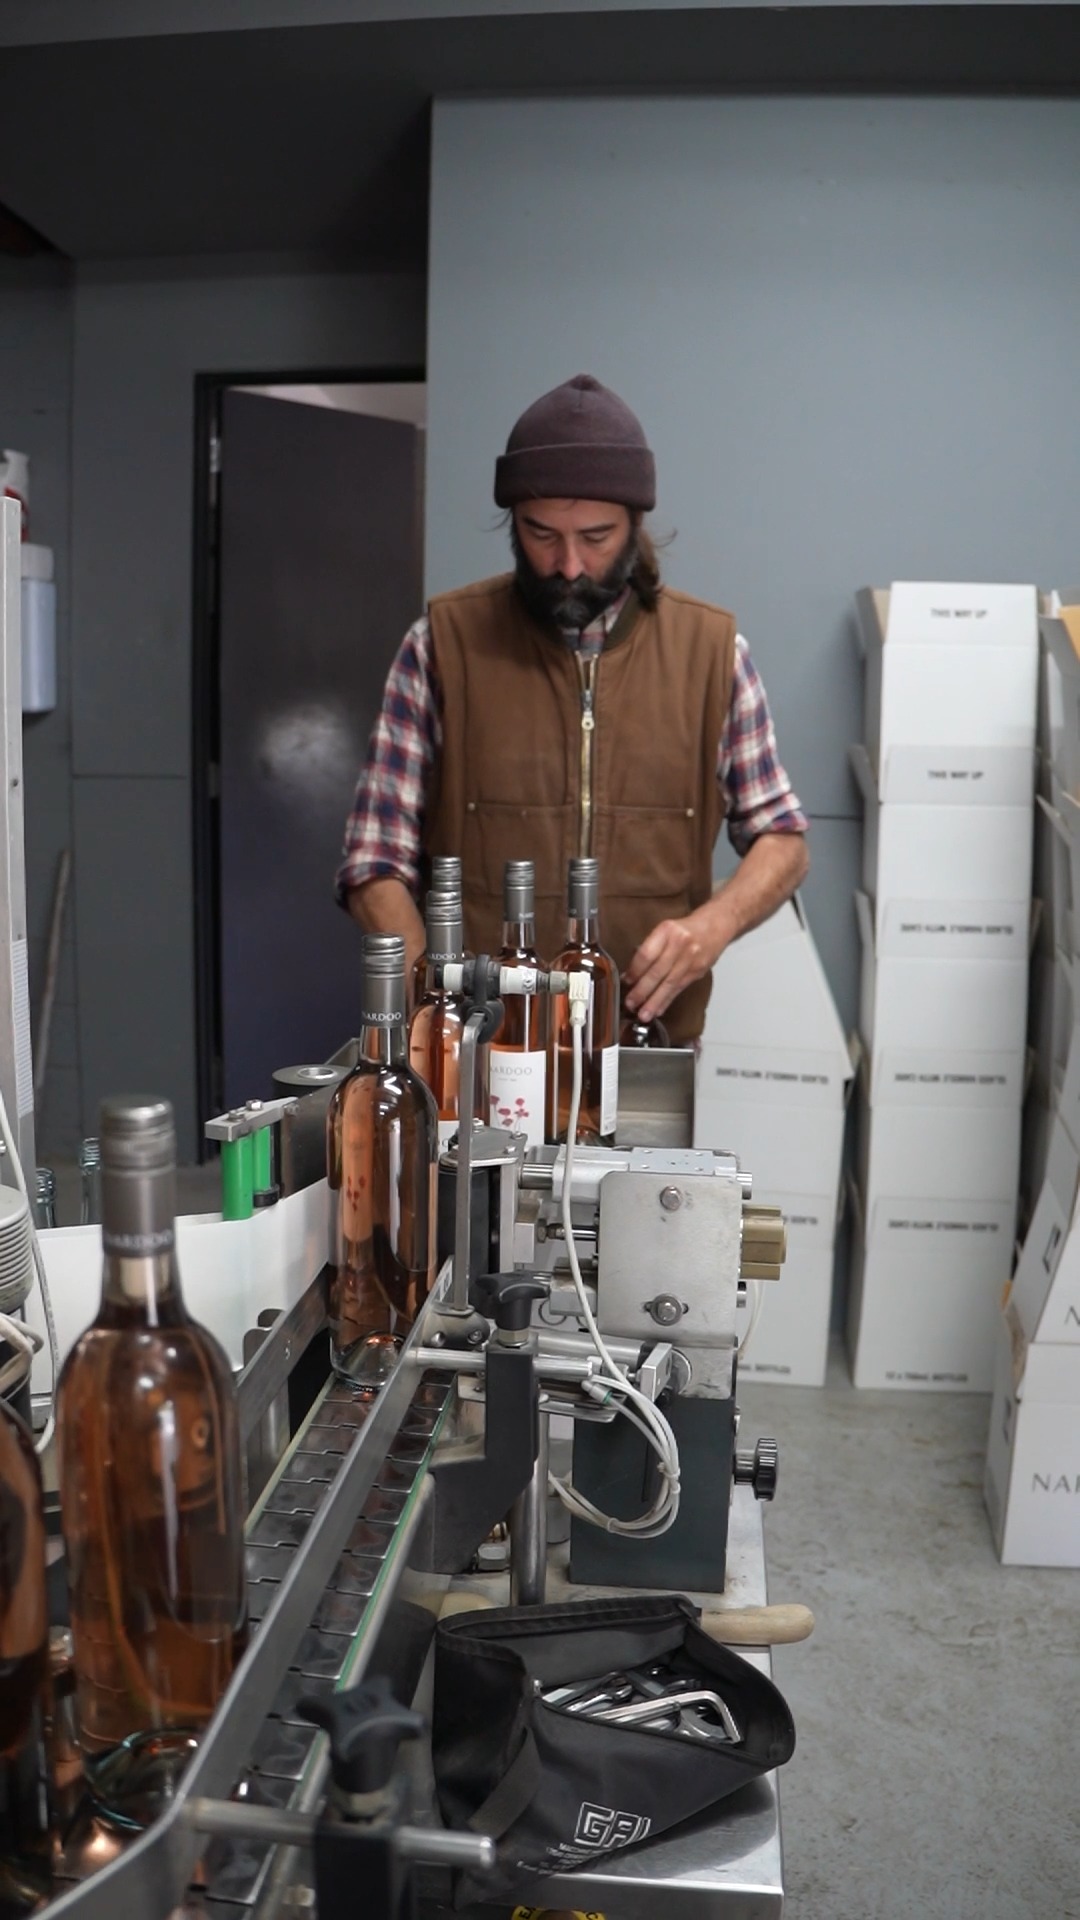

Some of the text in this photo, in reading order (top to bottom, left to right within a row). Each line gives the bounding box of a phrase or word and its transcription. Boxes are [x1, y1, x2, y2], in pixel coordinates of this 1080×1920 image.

[931, 608, 988, 619] THIS WAY UP
[928, 770, 984, 780] THIS WAY UP
